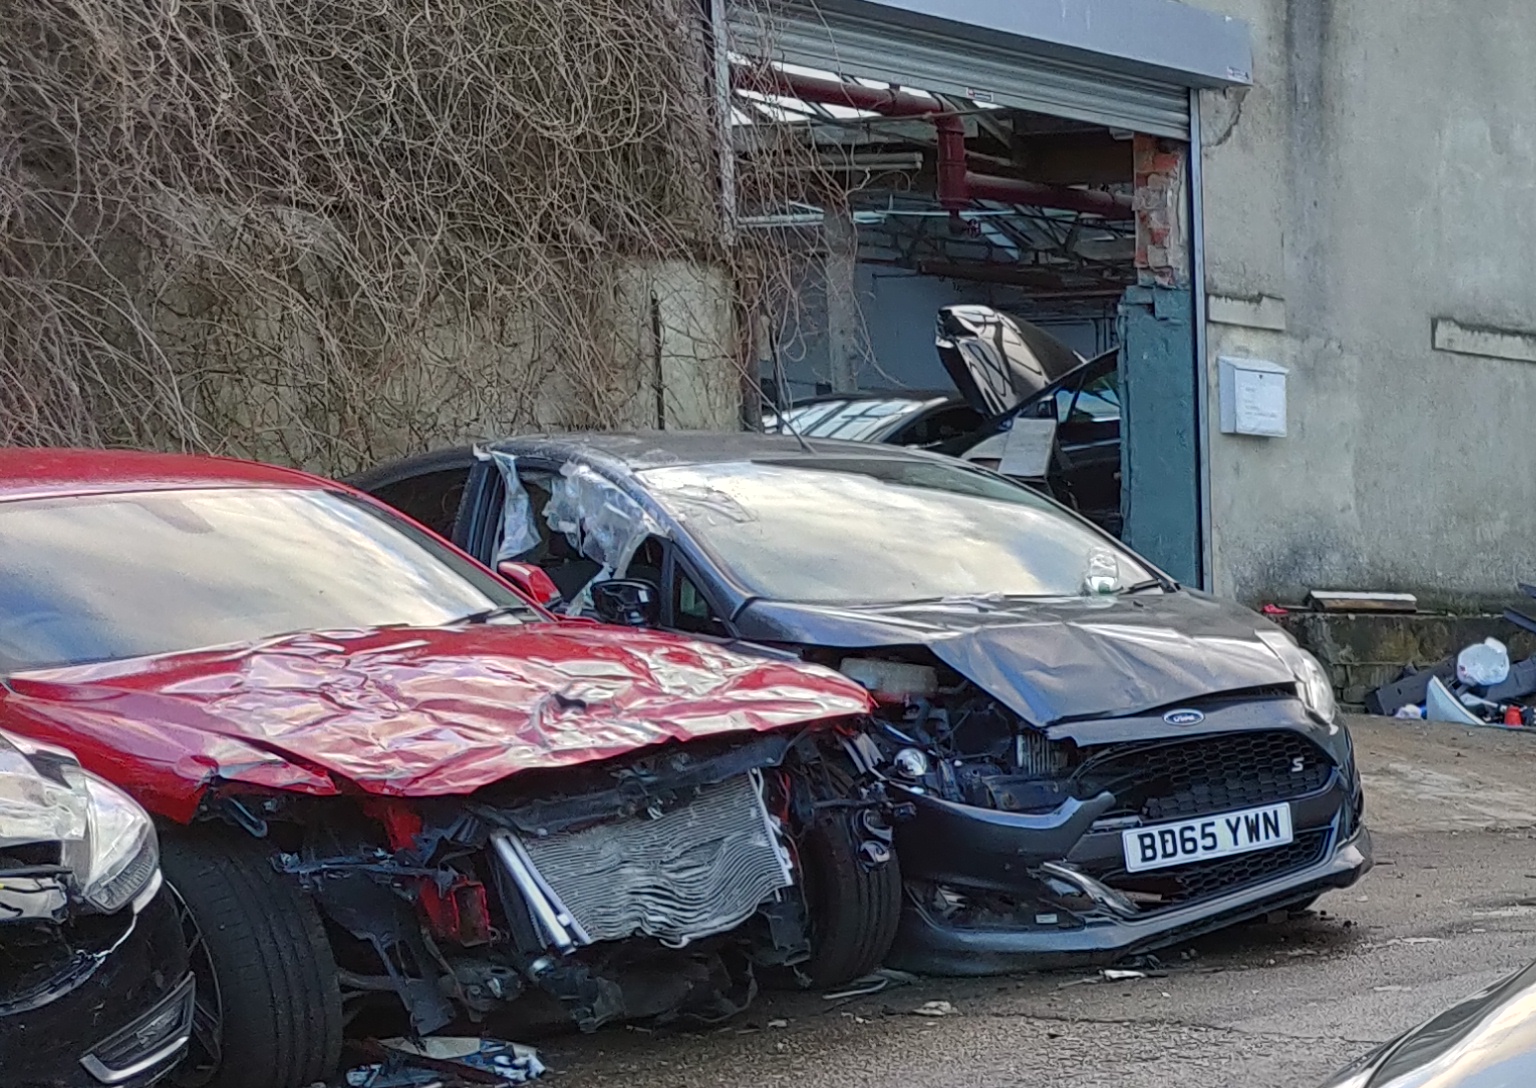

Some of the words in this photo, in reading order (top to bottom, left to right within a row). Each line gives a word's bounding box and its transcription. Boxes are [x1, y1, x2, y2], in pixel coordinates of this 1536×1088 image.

[1291, 757, 1304, 772] S
[1137, 822, 1218, 863] BD65
[1225, 810, 1281, 847] YWN
